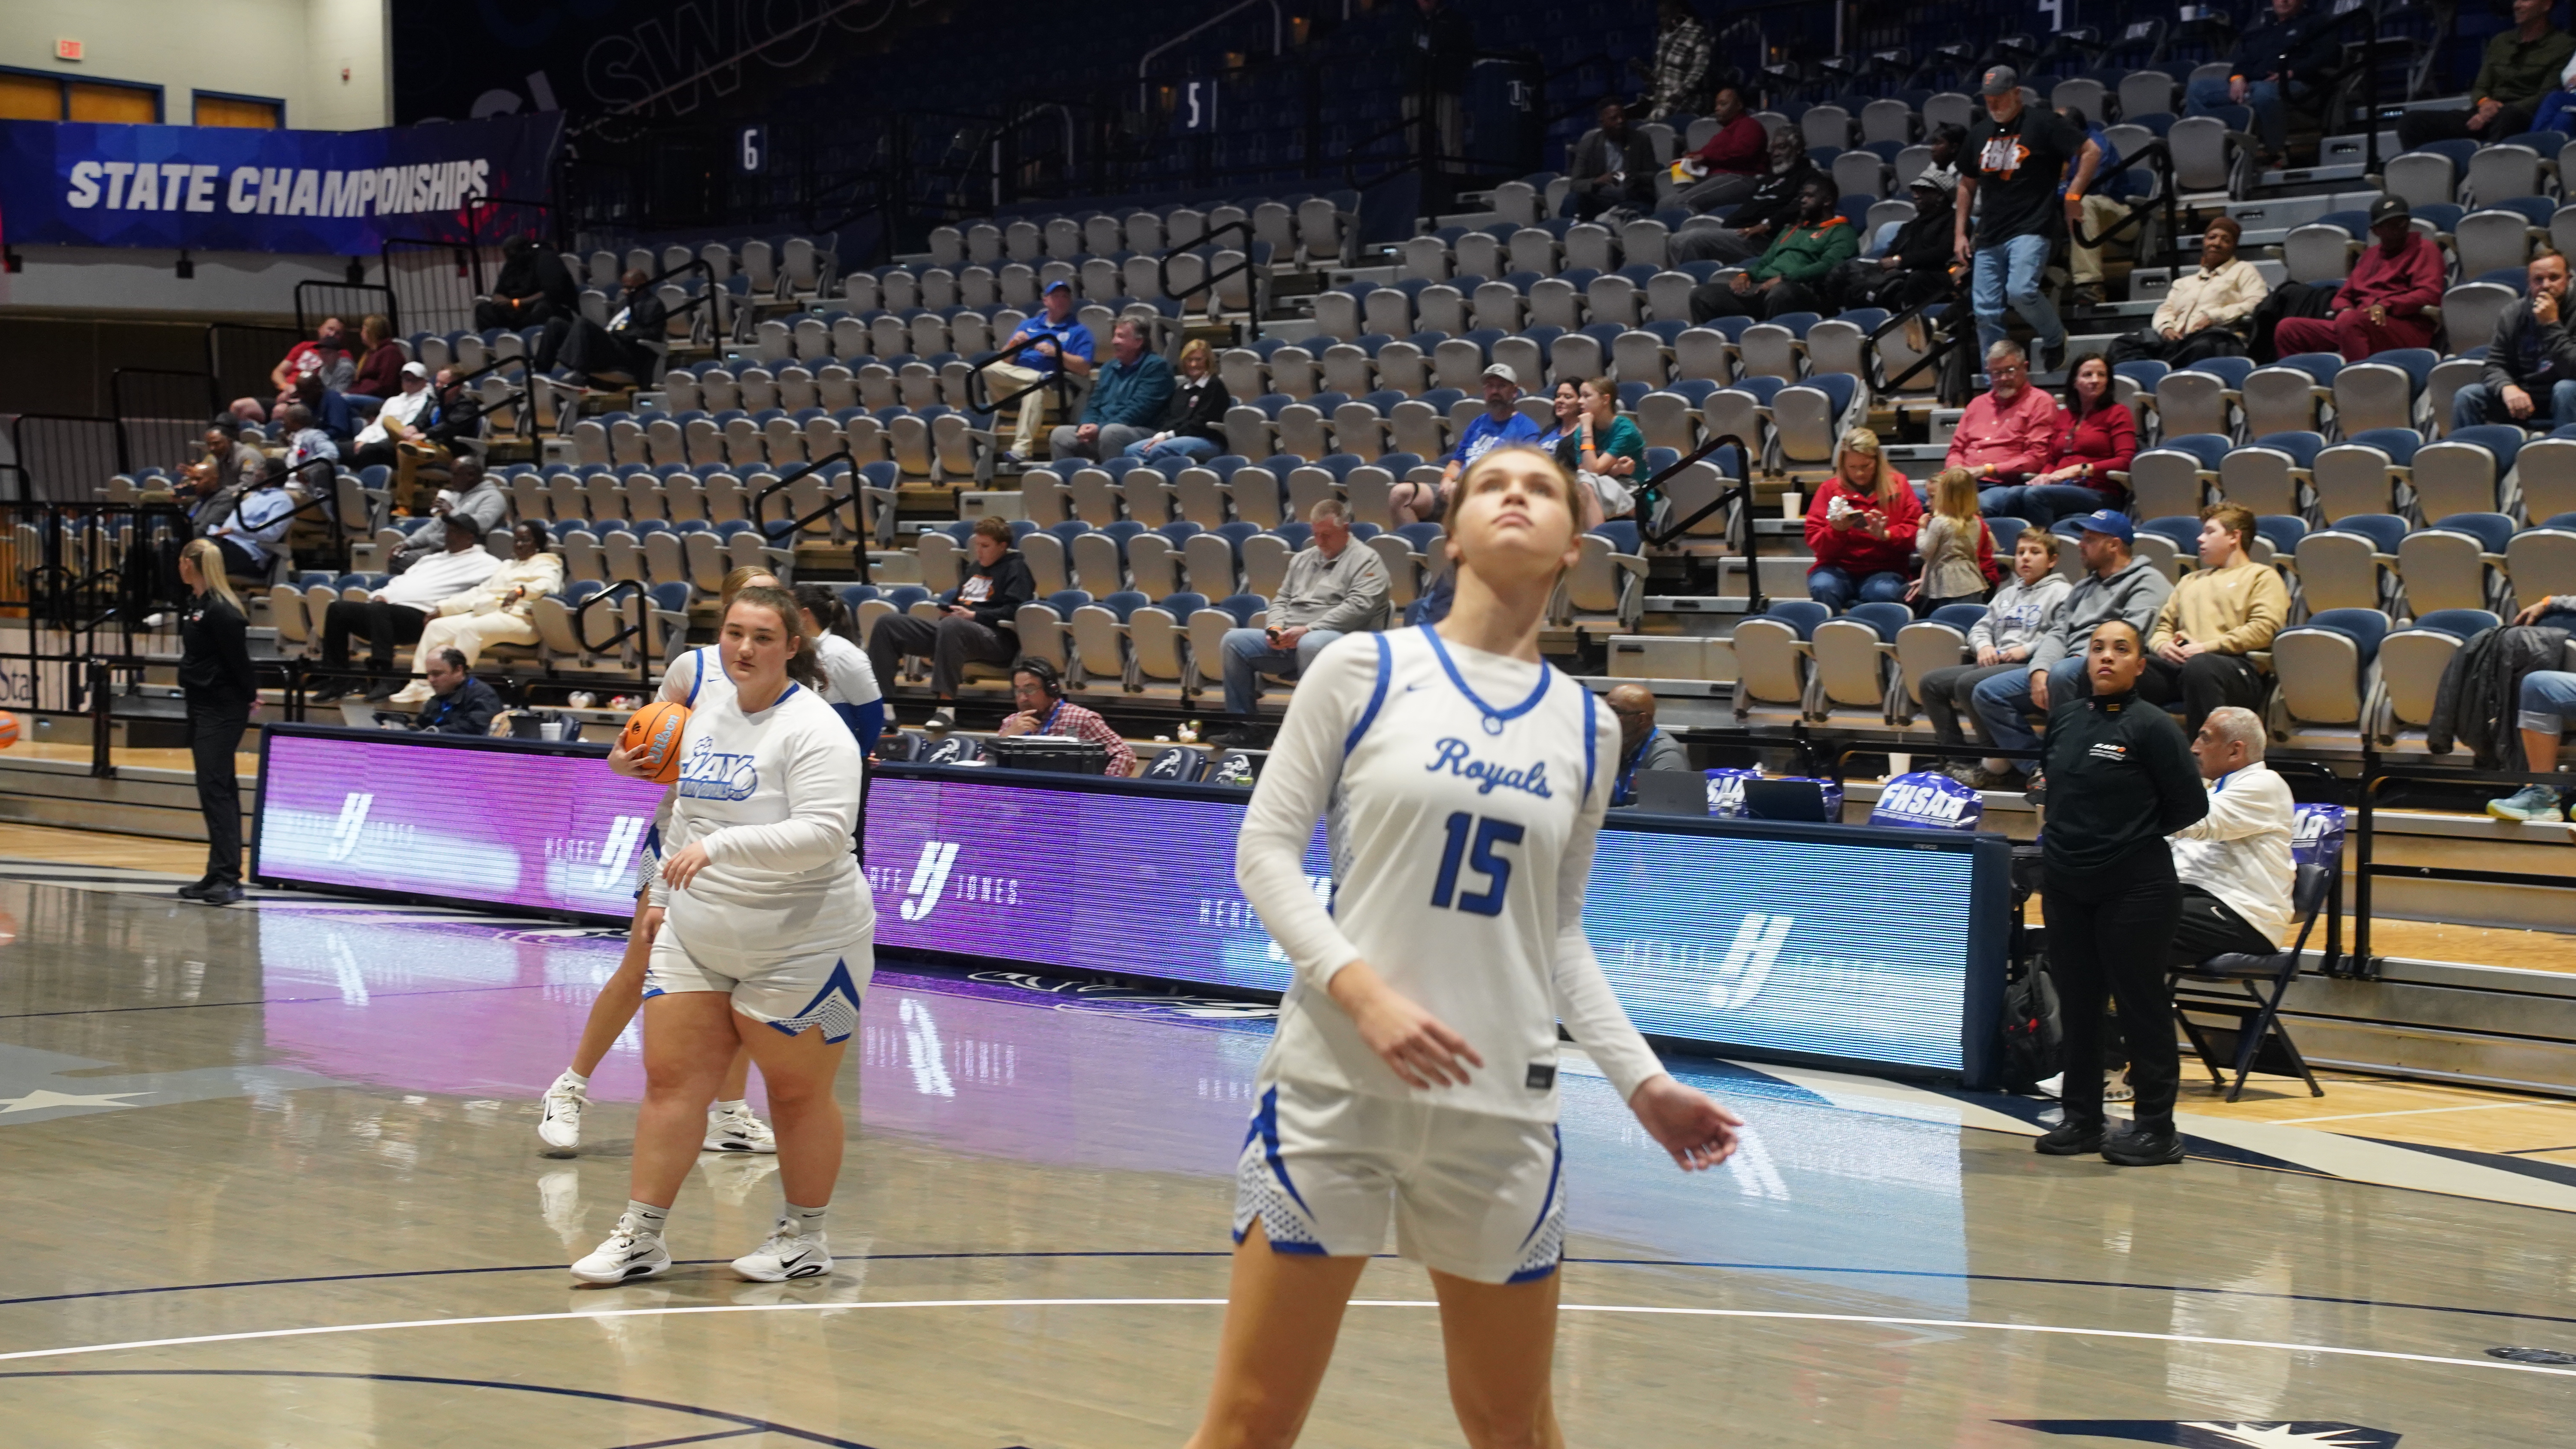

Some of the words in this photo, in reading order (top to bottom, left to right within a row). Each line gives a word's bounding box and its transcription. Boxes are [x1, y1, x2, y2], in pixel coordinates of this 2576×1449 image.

[1187, 82, 1201, 128] 5
[743, 129, 758, 170] 6
[67, 161, 219, 213] STATE
[227, 158, 489, 218] CHAMPIONSHIPS
[647, 714, 681, 764] Wilson
[679, 752, 755, 785] JAY
[1425, 737, 1553, 799] Royals
[1706, 776, 1746, 803] SAA
[1875, 783, 1970, 820] FHSAA
[1431, 809, 1526, 918] 15
[869, 867, 902, 892] RFF
[956, 875, 1018, 904] JONES
[1199, 899, 1264, 931] HERF
